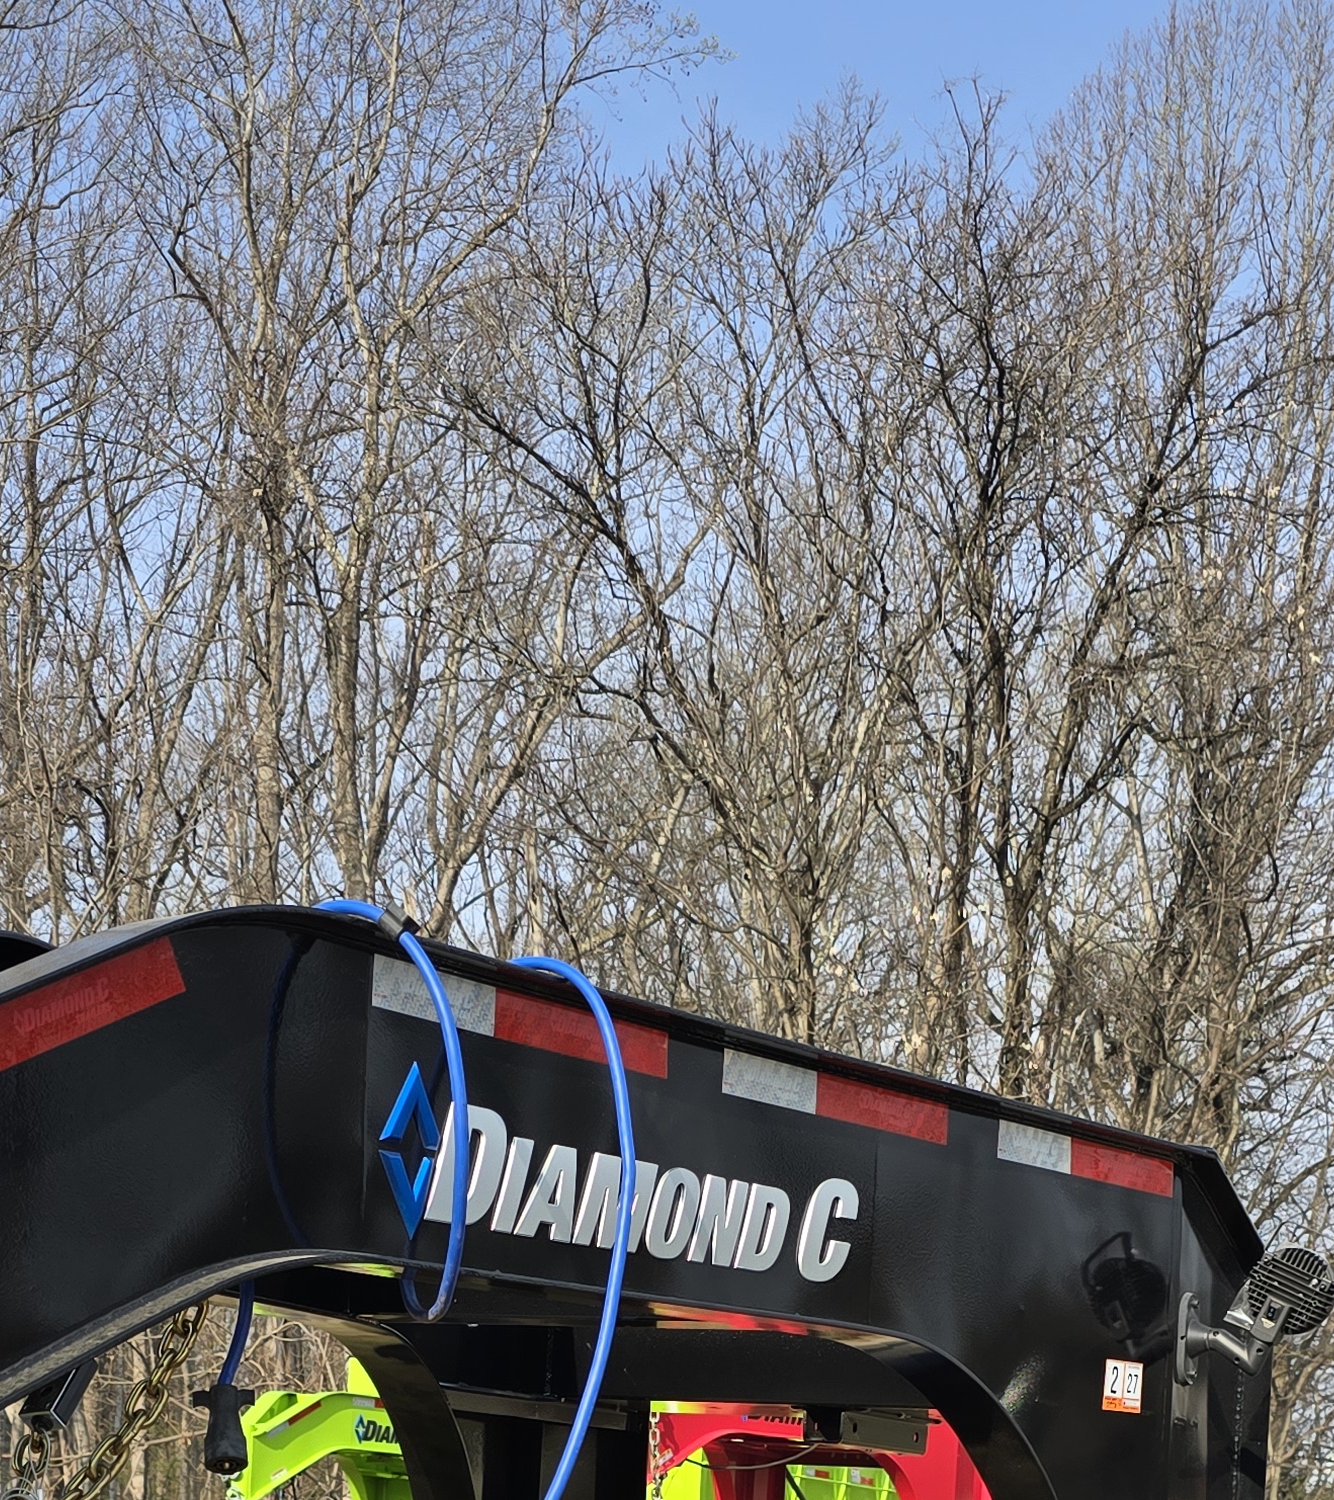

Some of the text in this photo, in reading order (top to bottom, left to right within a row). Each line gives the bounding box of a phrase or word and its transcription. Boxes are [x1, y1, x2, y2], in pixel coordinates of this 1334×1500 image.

[424, 1101, 860, 1283] DIAMOND C
[1110, 1366, 1119, 1394] 2
[1126, 1373, 1139, 1394] 27
